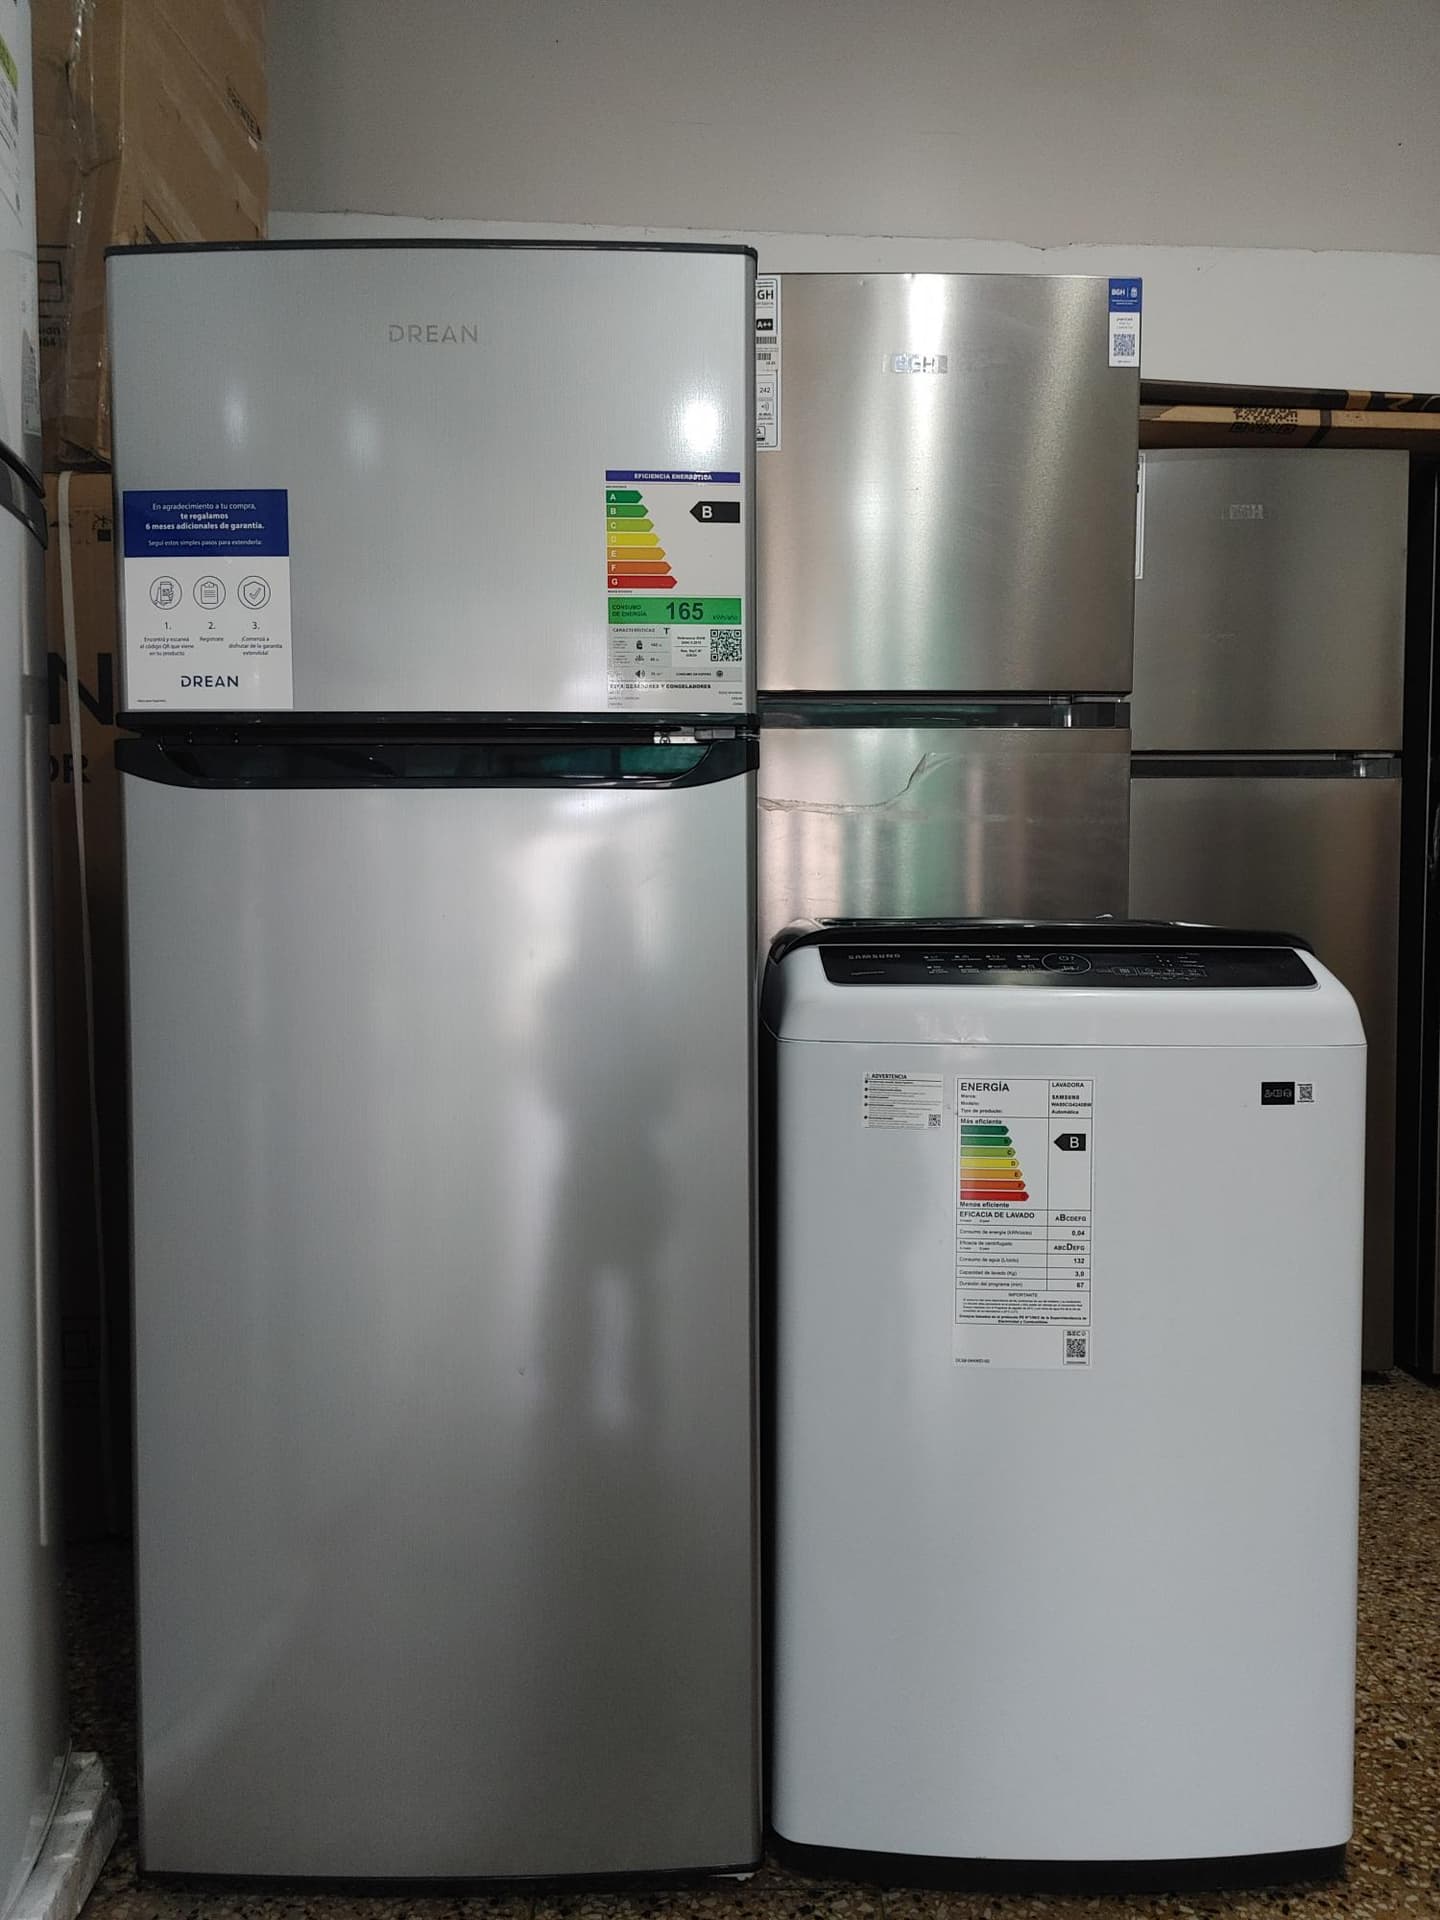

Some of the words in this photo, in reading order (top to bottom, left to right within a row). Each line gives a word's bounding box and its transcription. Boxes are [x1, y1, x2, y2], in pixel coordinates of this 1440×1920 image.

[757, 289, 774, 300] GH
[389, 324, 478, 343] DREAN
[162, 503, 214, 511] agradecimiento
[229, 503, 257, 512] compra,
[610, 507, 617, 515] B
[702, 506, 713, 518] B
[189, 512, 229, 521] regalamos
[176, 522, 218, 530] adicionales
[610, 521, 617, 529] C
[180, 539, 201, 547] simples
[611, 550, 617, 558] E
[611, 564, 617, 572] F
[611, 578, 619, 586] G
[665, 602, 704, 620] 165
[164, 621, 172, 630] 1.
[208, 621, 216, 630] 2.
[251, 621, 261, 630] 3.
[663, 627, 671, 635] T
[181, 675, 239, 688] DREAN
[960, 1081, 1010, 1092] ENERGÍA
[1070, 1136, 1080, 1149] B
